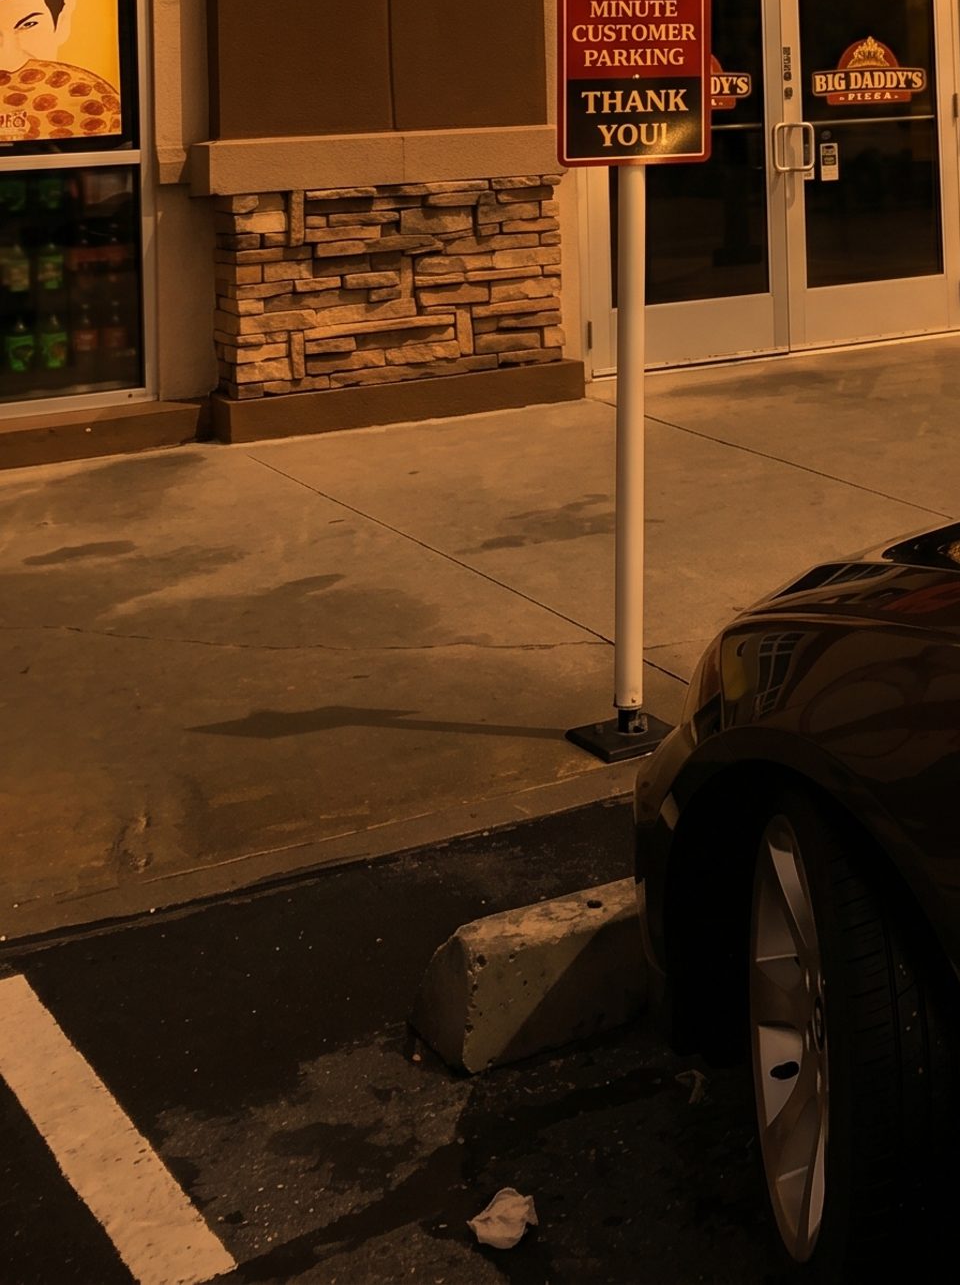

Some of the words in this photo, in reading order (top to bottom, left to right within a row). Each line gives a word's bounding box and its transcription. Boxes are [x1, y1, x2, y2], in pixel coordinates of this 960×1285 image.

[589, 0, 678, 18] MINUTE
[571, 23, 697, 43] CUSTOMER
[583, 47, 685, 67] PARKING
[711, 76, 749, 95] DY'S
[815, 73, 846, 92] BIG
[849, 71, 923, 90] DADDY'S
[581, 89, 689, 114] THANK
[597, 122, 669, 147] YOU!
